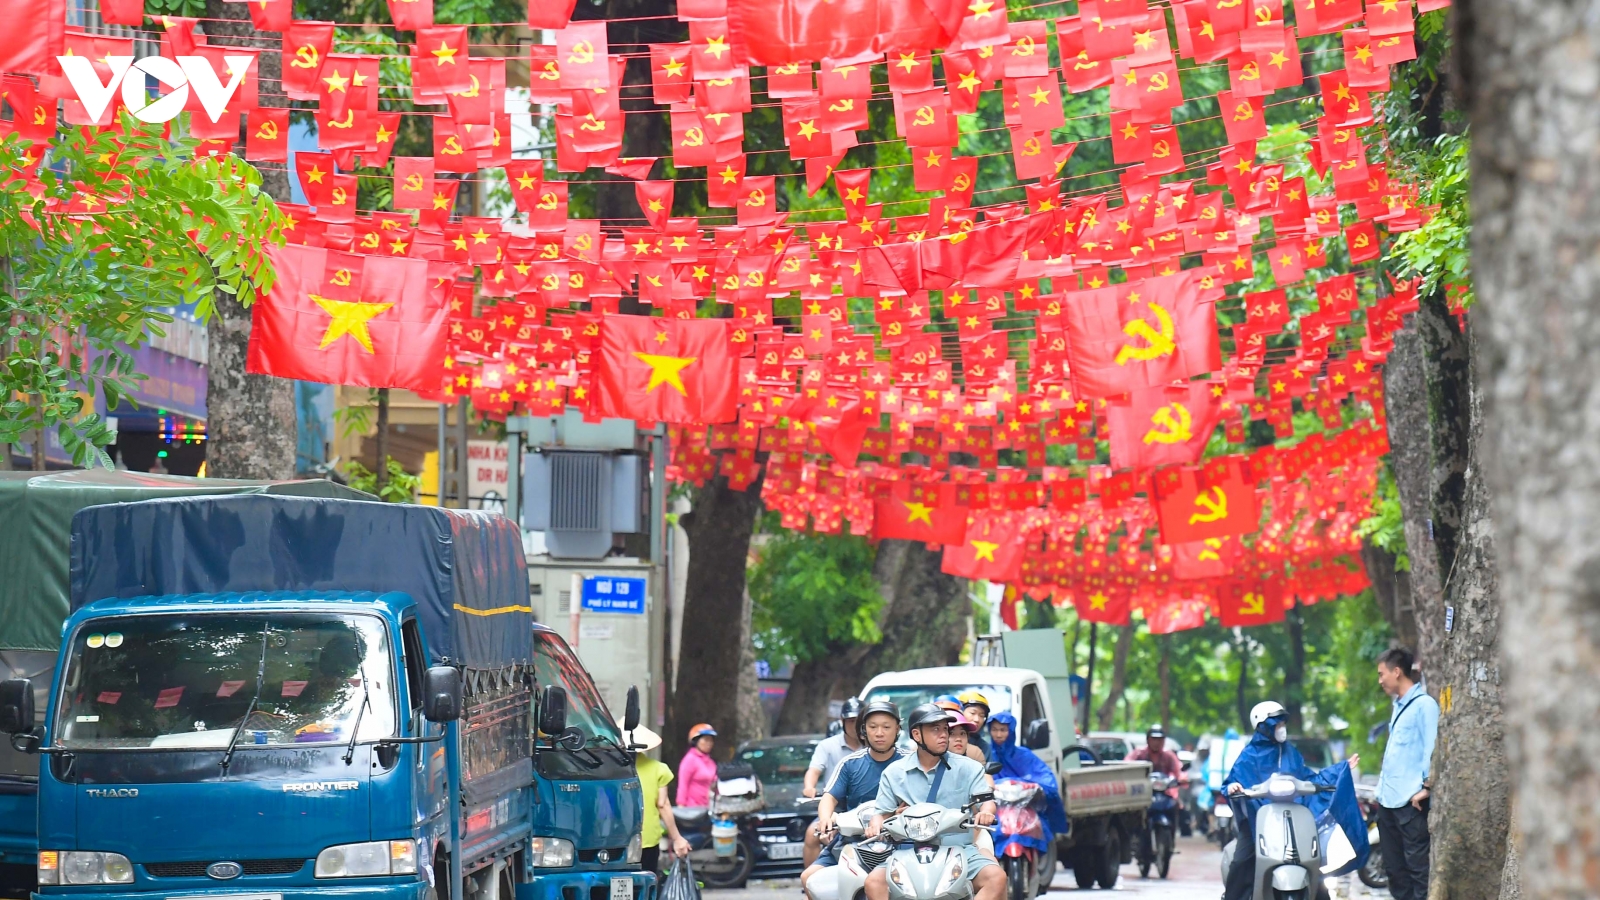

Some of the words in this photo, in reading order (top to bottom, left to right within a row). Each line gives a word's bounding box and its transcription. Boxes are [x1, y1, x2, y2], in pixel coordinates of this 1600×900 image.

[468, 446, 491, 460] NHA
[477, 467, 493, 482] DR
[86, 788, 139, 798] THACO
[282, 781, 359, 793] FRONTIER
[213, 866, 236, 875] KIA
